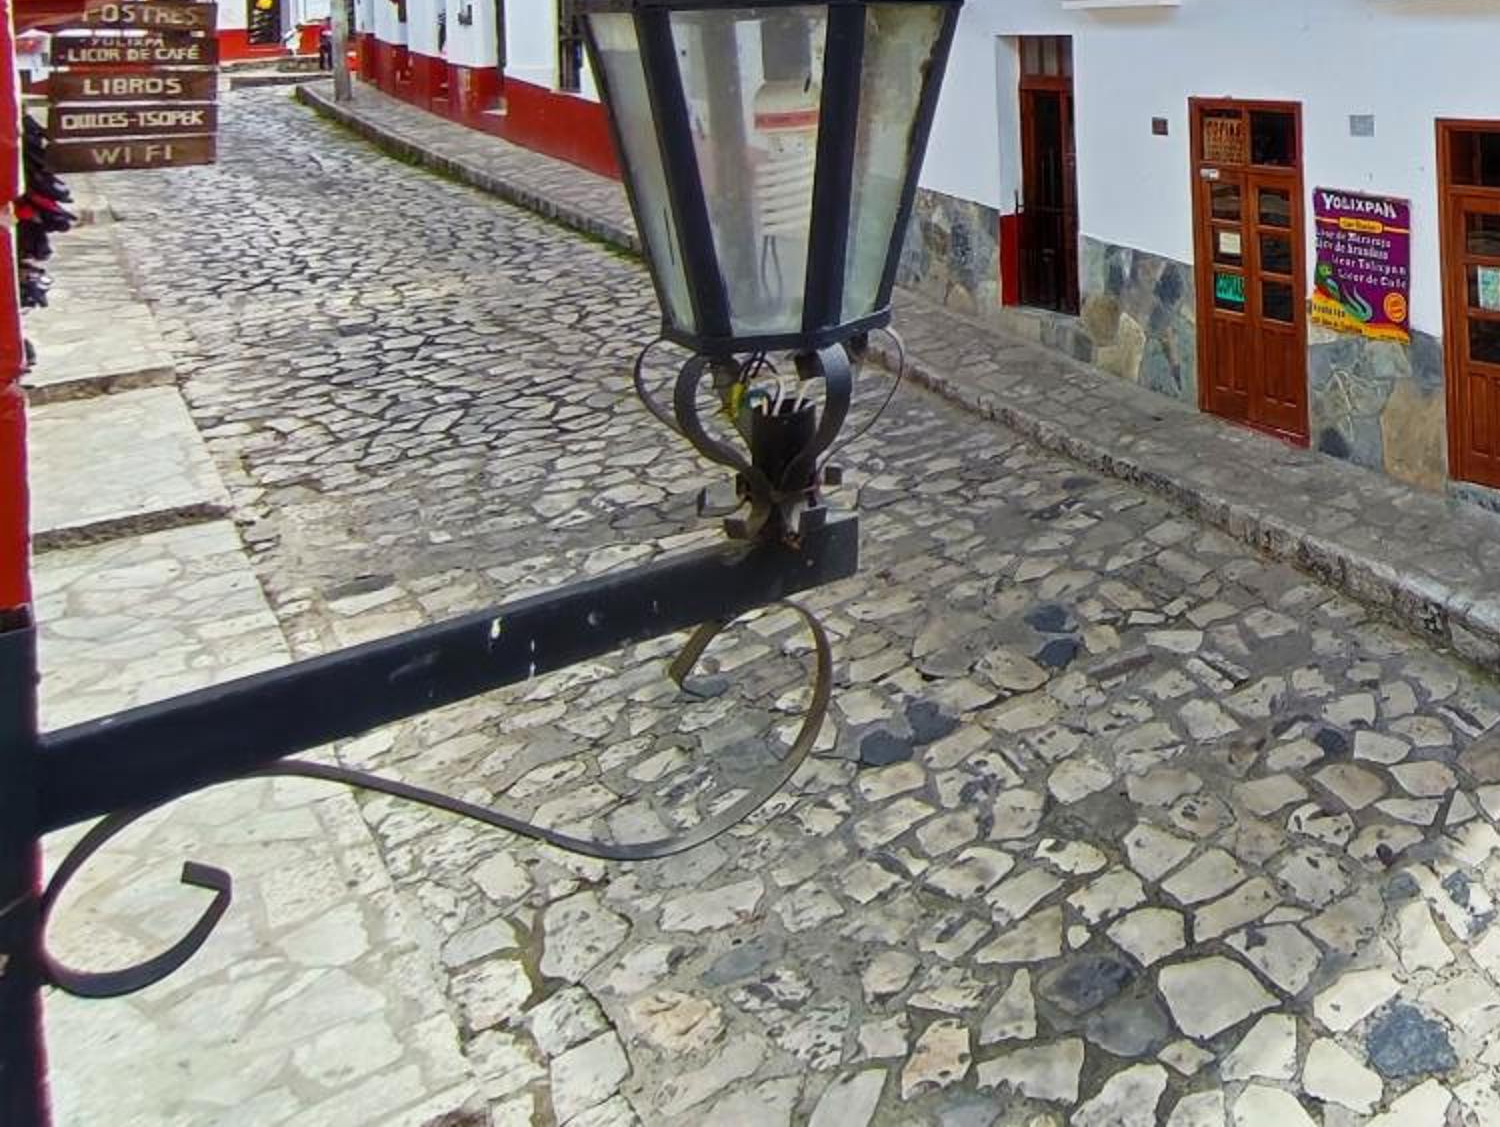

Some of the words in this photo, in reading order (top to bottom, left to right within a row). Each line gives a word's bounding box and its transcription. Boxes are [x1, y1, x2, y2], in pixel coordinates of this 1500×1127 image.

[67, 47, 121, 62] LICOR
[127, 47, 150, 61] DE
[155, 45, 201, 60] CAFÉ
[83, 77, 182, 95] LIBROS
